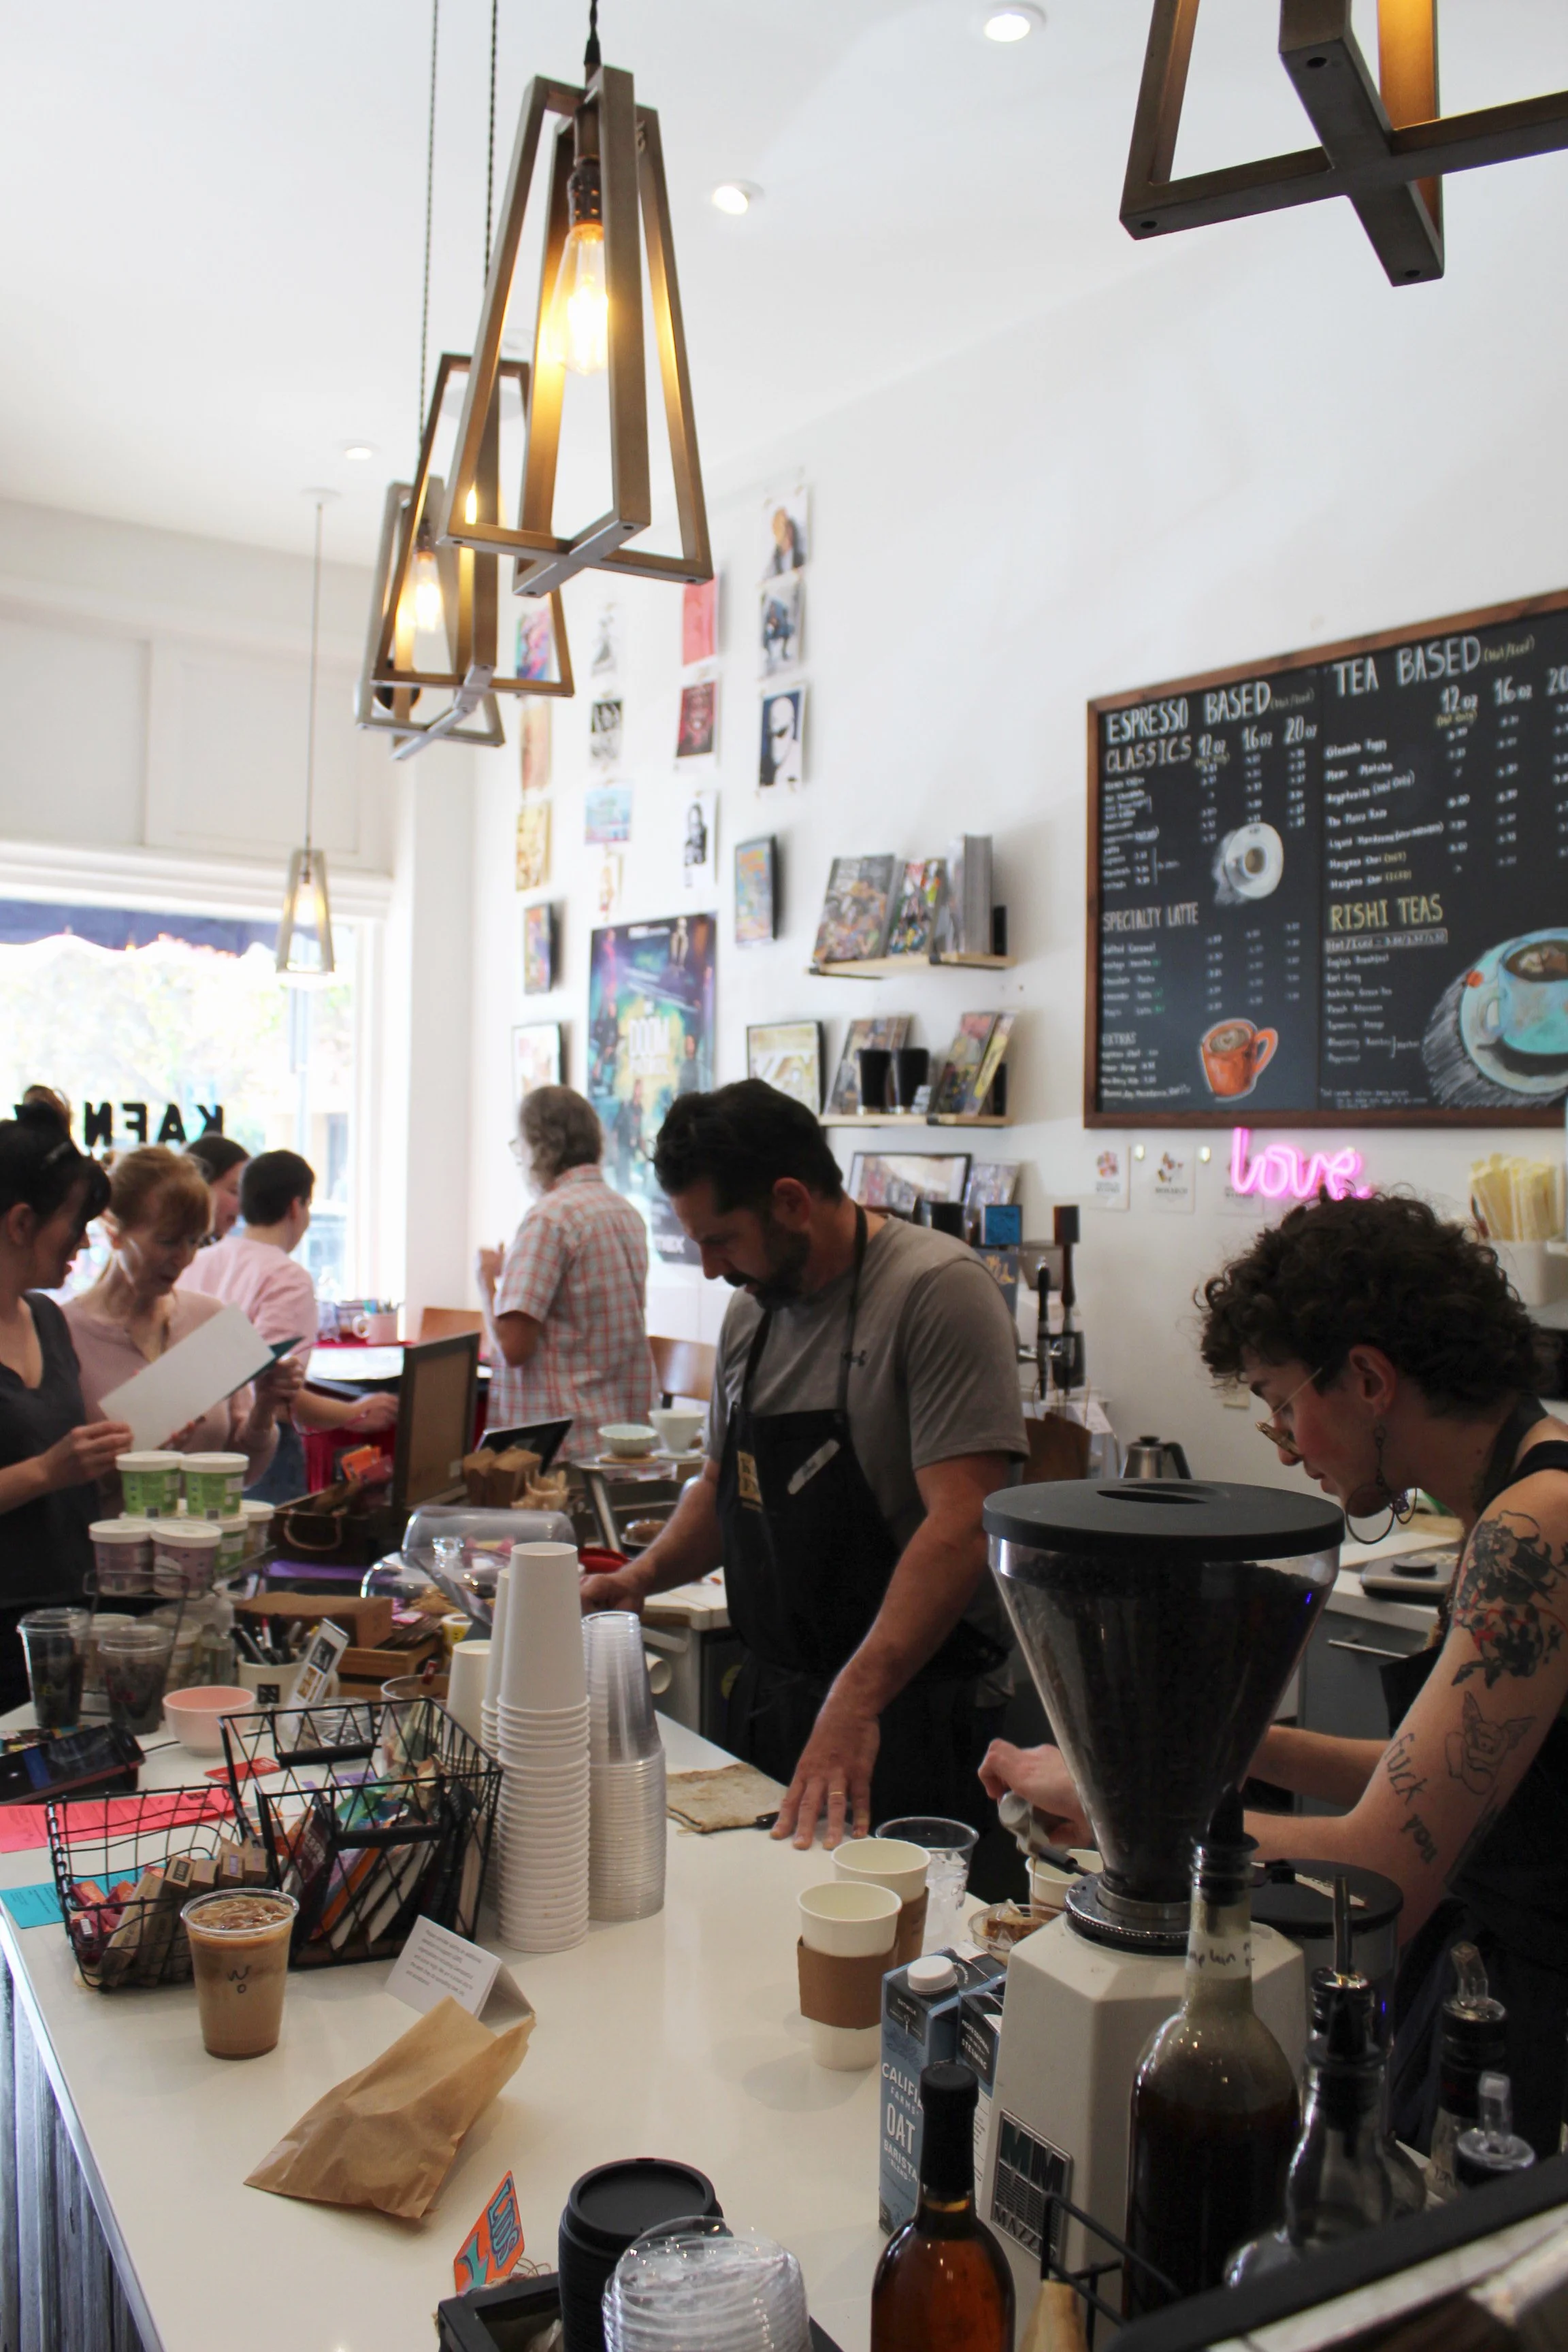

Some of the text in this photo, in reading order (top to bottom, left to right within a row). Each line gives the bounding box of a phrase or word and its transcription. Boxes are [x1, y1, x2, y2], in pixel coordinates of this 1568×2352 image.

[1333, 656, 1379, 697] TEA
[1396, 636, 1481, 686] BASED
[1107, 697, 1189, 745] ESPRESSO
[1204, 681, 1271, 725] BASED
[1106, 735, 1192, 774] CLASSICS
[1103, 902, 1198, 932] SPECIALTY LATTE
[1330, 893, 1443, 932] RISHI TEAS
[962, 2038, 987, 2070] STEAMING
[887, 2102, 915, 2155] OAT
[883, 2138, 918, 2183] BARISTA
[487, 2176, 520, 2269] LIDS
